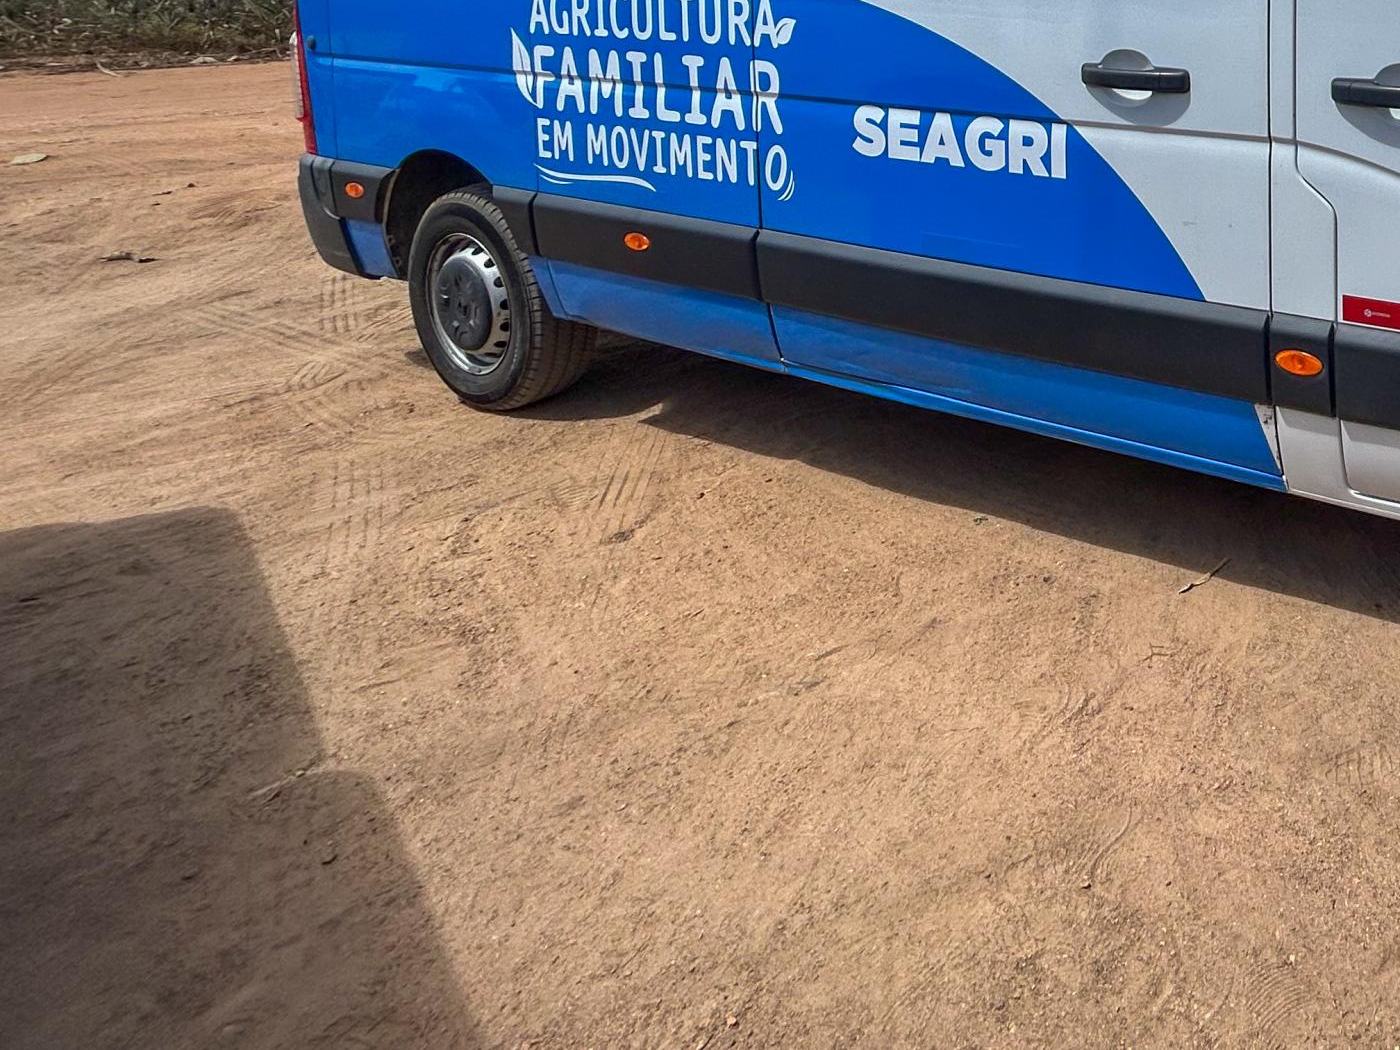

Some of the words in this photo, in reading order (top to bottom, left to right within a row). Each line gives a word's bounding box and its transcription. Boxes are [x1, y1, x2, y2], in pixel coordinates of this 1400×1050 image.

[533, 46, 783, 135] FAMILIAR
[537, 117, 574, 161] EM
[586, 123, 787, 192] MOVIMENTO
[852, 105, 1067, 179] SEAGRI
